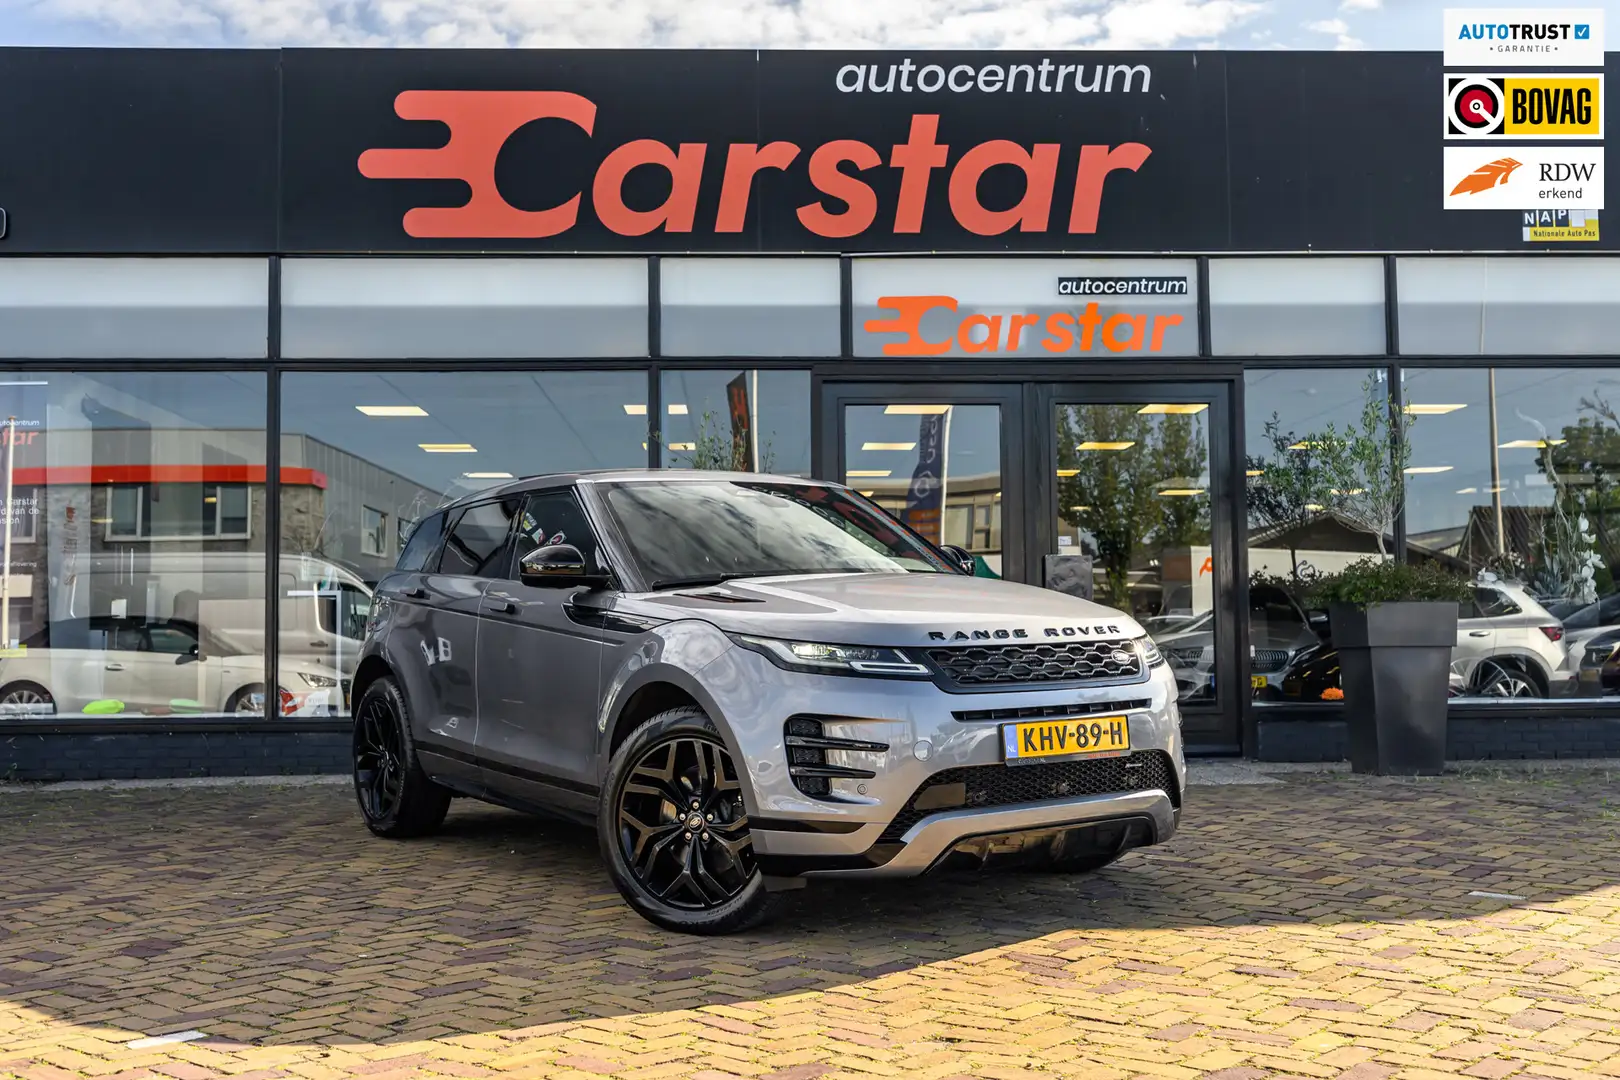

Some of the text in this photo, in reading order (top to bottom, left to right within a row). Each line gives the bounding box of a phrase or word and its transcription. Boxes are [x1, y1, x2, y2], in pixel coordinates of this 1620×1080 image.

[835, 58, 1152, 93] autocentrum
[357, 90, 1153, 239] Carstar
[1524, 209, 1567, 225] NAP
[1533, 229, 1596, 237] Nationale Auto Pas
[1059, 278, 1187, 294] autocentrum
[864, 295, 1184, 356] Carstar
[928, 625, 1121, 641] RANGE ROVER
[1023, 721, 1123, 752] KHV-89-H
[1007, 744, 1017, 753] NL
